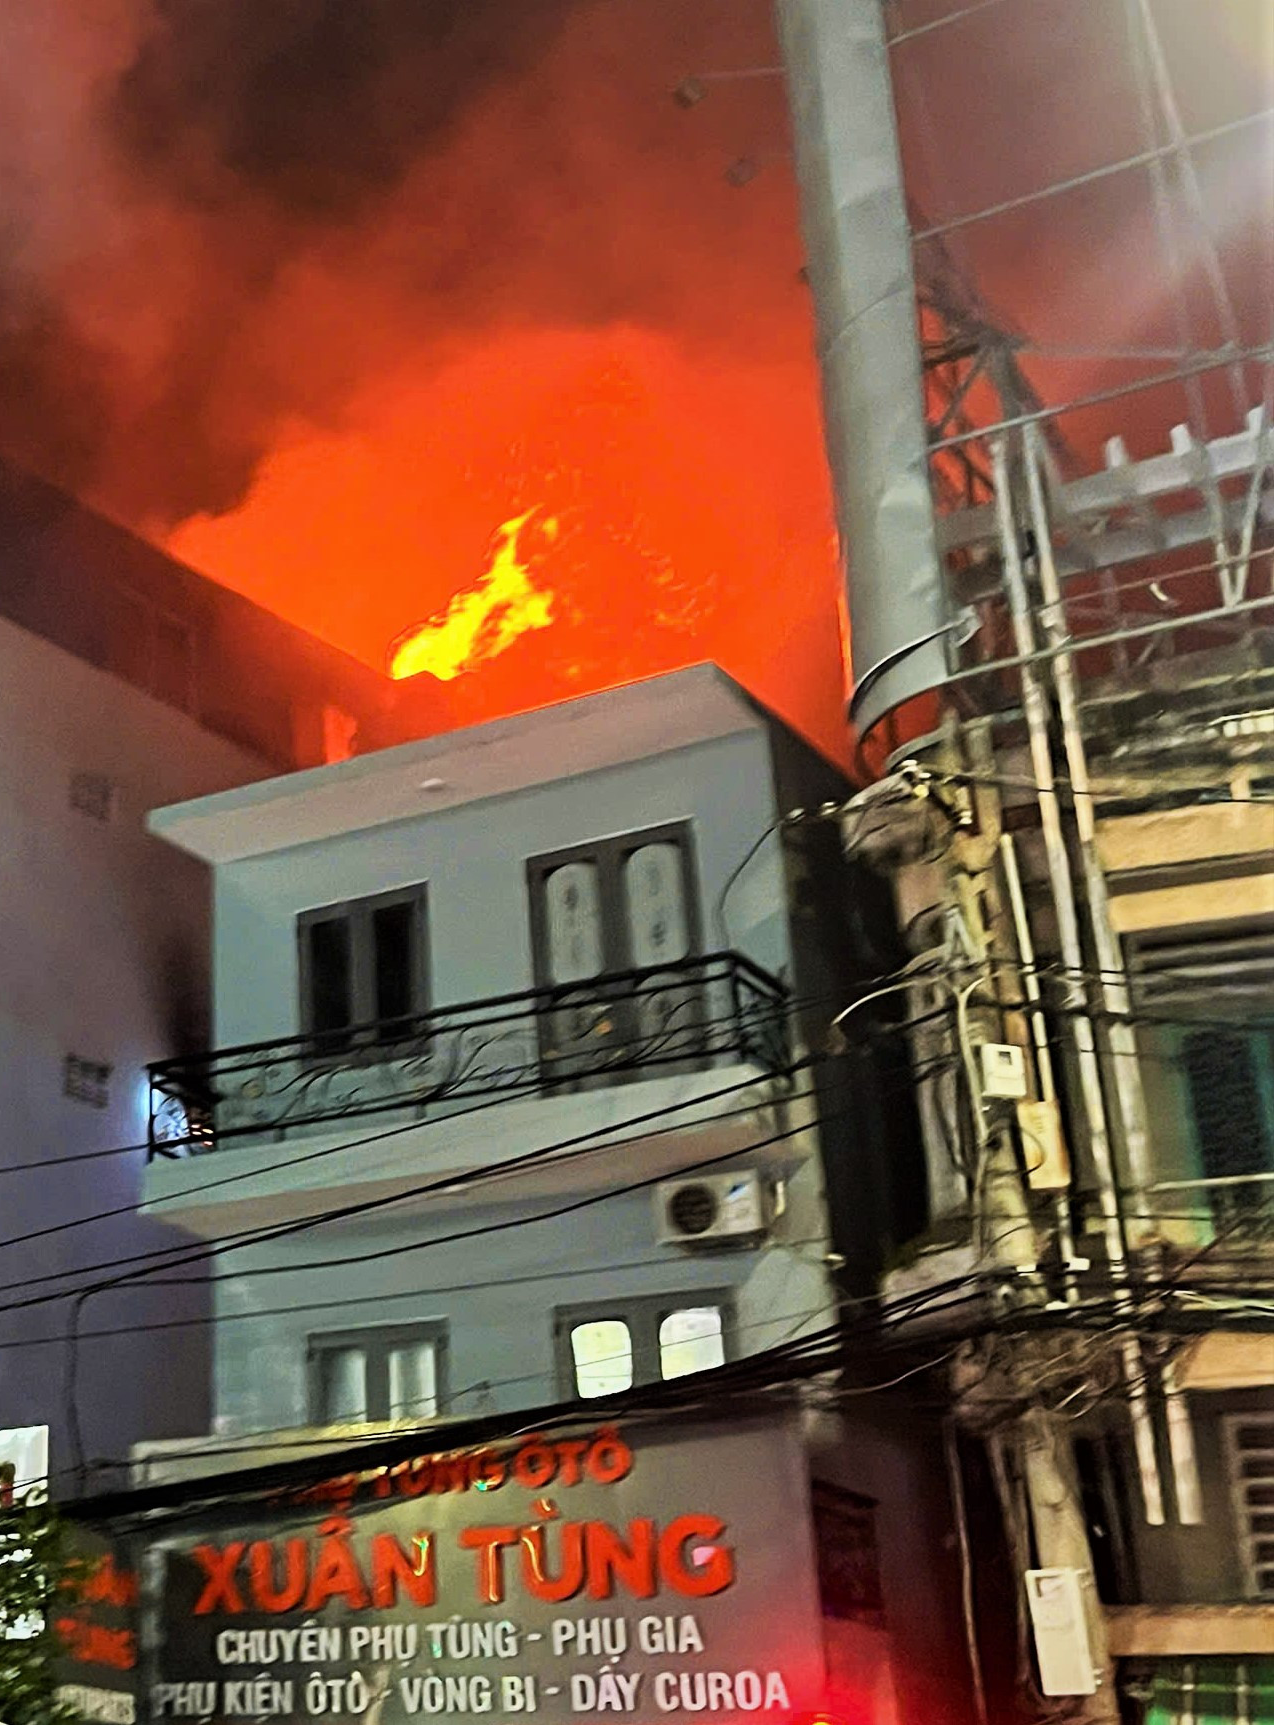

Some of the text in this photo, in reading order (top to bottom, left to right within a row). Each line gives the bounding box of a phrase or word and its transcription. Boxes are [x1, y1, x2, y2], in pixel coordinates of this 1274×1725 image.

[512, 1425, 633, 1489] ÔTÔ
[192, 1514, 437, 1617] XUÂN
[458, 1497, 736, 1605] TÙNG
[216, 1618, 341, 1665] CHUYÊN
[349, 1622, 418, 1669] PHỤ
[425, 1614, 519, 1660] TÙNG
[551, 1616, 627, 1664] PHỤ
[638, 1614, 705, 1655] GIA
[150, 1680, 217, 1725] PHỤ
[223, 1671, 294, 1725] KIỆN
[501, 1674, 538, 1713] BI
[654, 1669, 791, 1715] CUROA
